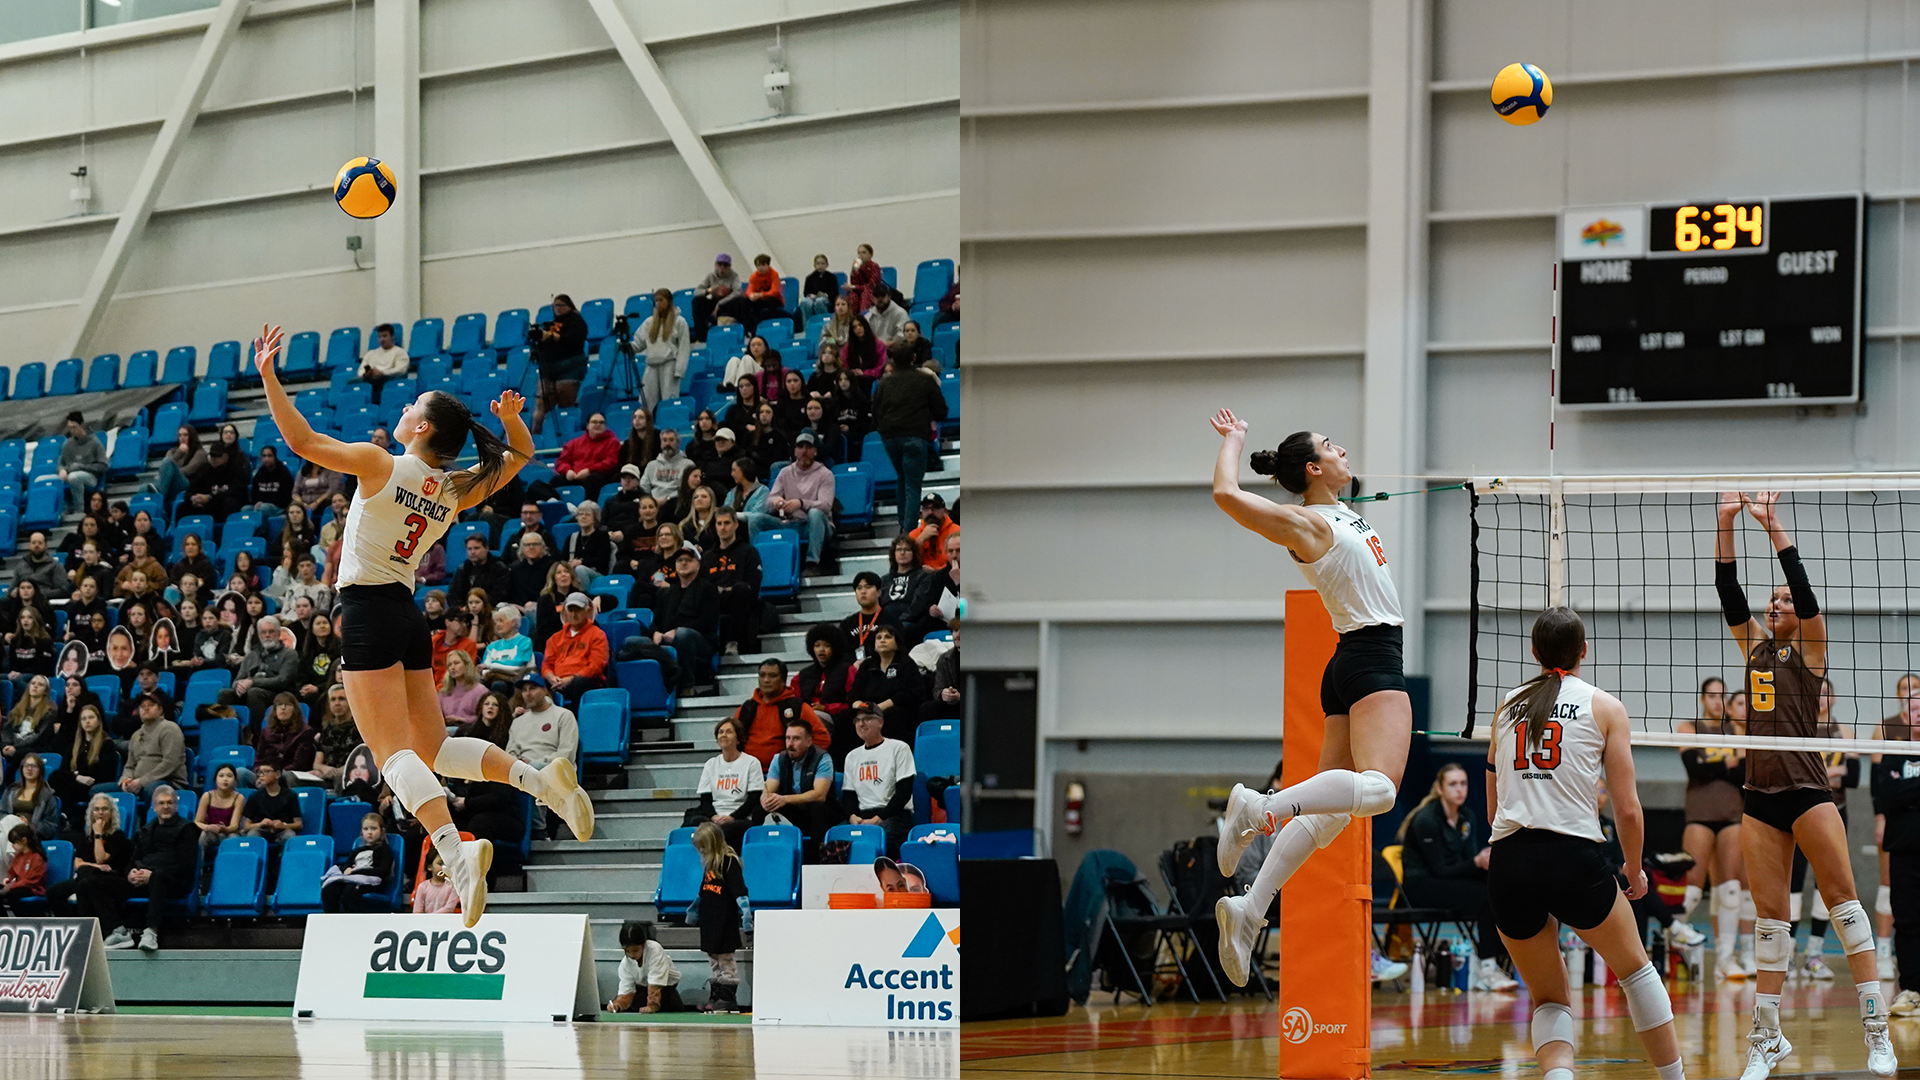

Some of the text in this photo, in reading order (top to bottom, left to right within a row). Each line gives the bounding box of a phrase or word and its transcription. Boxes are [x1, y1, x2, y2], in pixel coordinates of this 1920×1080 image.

[1675, 203, 1763, 252] 6:34
[1580, 260, 1632, 284] HOME
[1683, 266, 1729, 285] PERIOD
[1777, 250, 1838, 276] GUEST
[1571, 335, 1602, 352] WON
[1811, 326, 1842, 344] WON
[395, 486, 451, 523] WOLFPACK
[394, 512, 429, 559] 3
[1366, 535, 1387, 567] 16
[1750, 669, 1776, 712] 6
[1514, 720, 1563, 771] 13
[717, 778, 739, 790] MOM
[859, 765, 878, 781] DAD
[370, 930, 507, 973] acres
[844, 963, 954, 990] Accent
[887, 993, 953, 1021] Inns
[1282, 1012, 1347, 1040] SA SPORT
